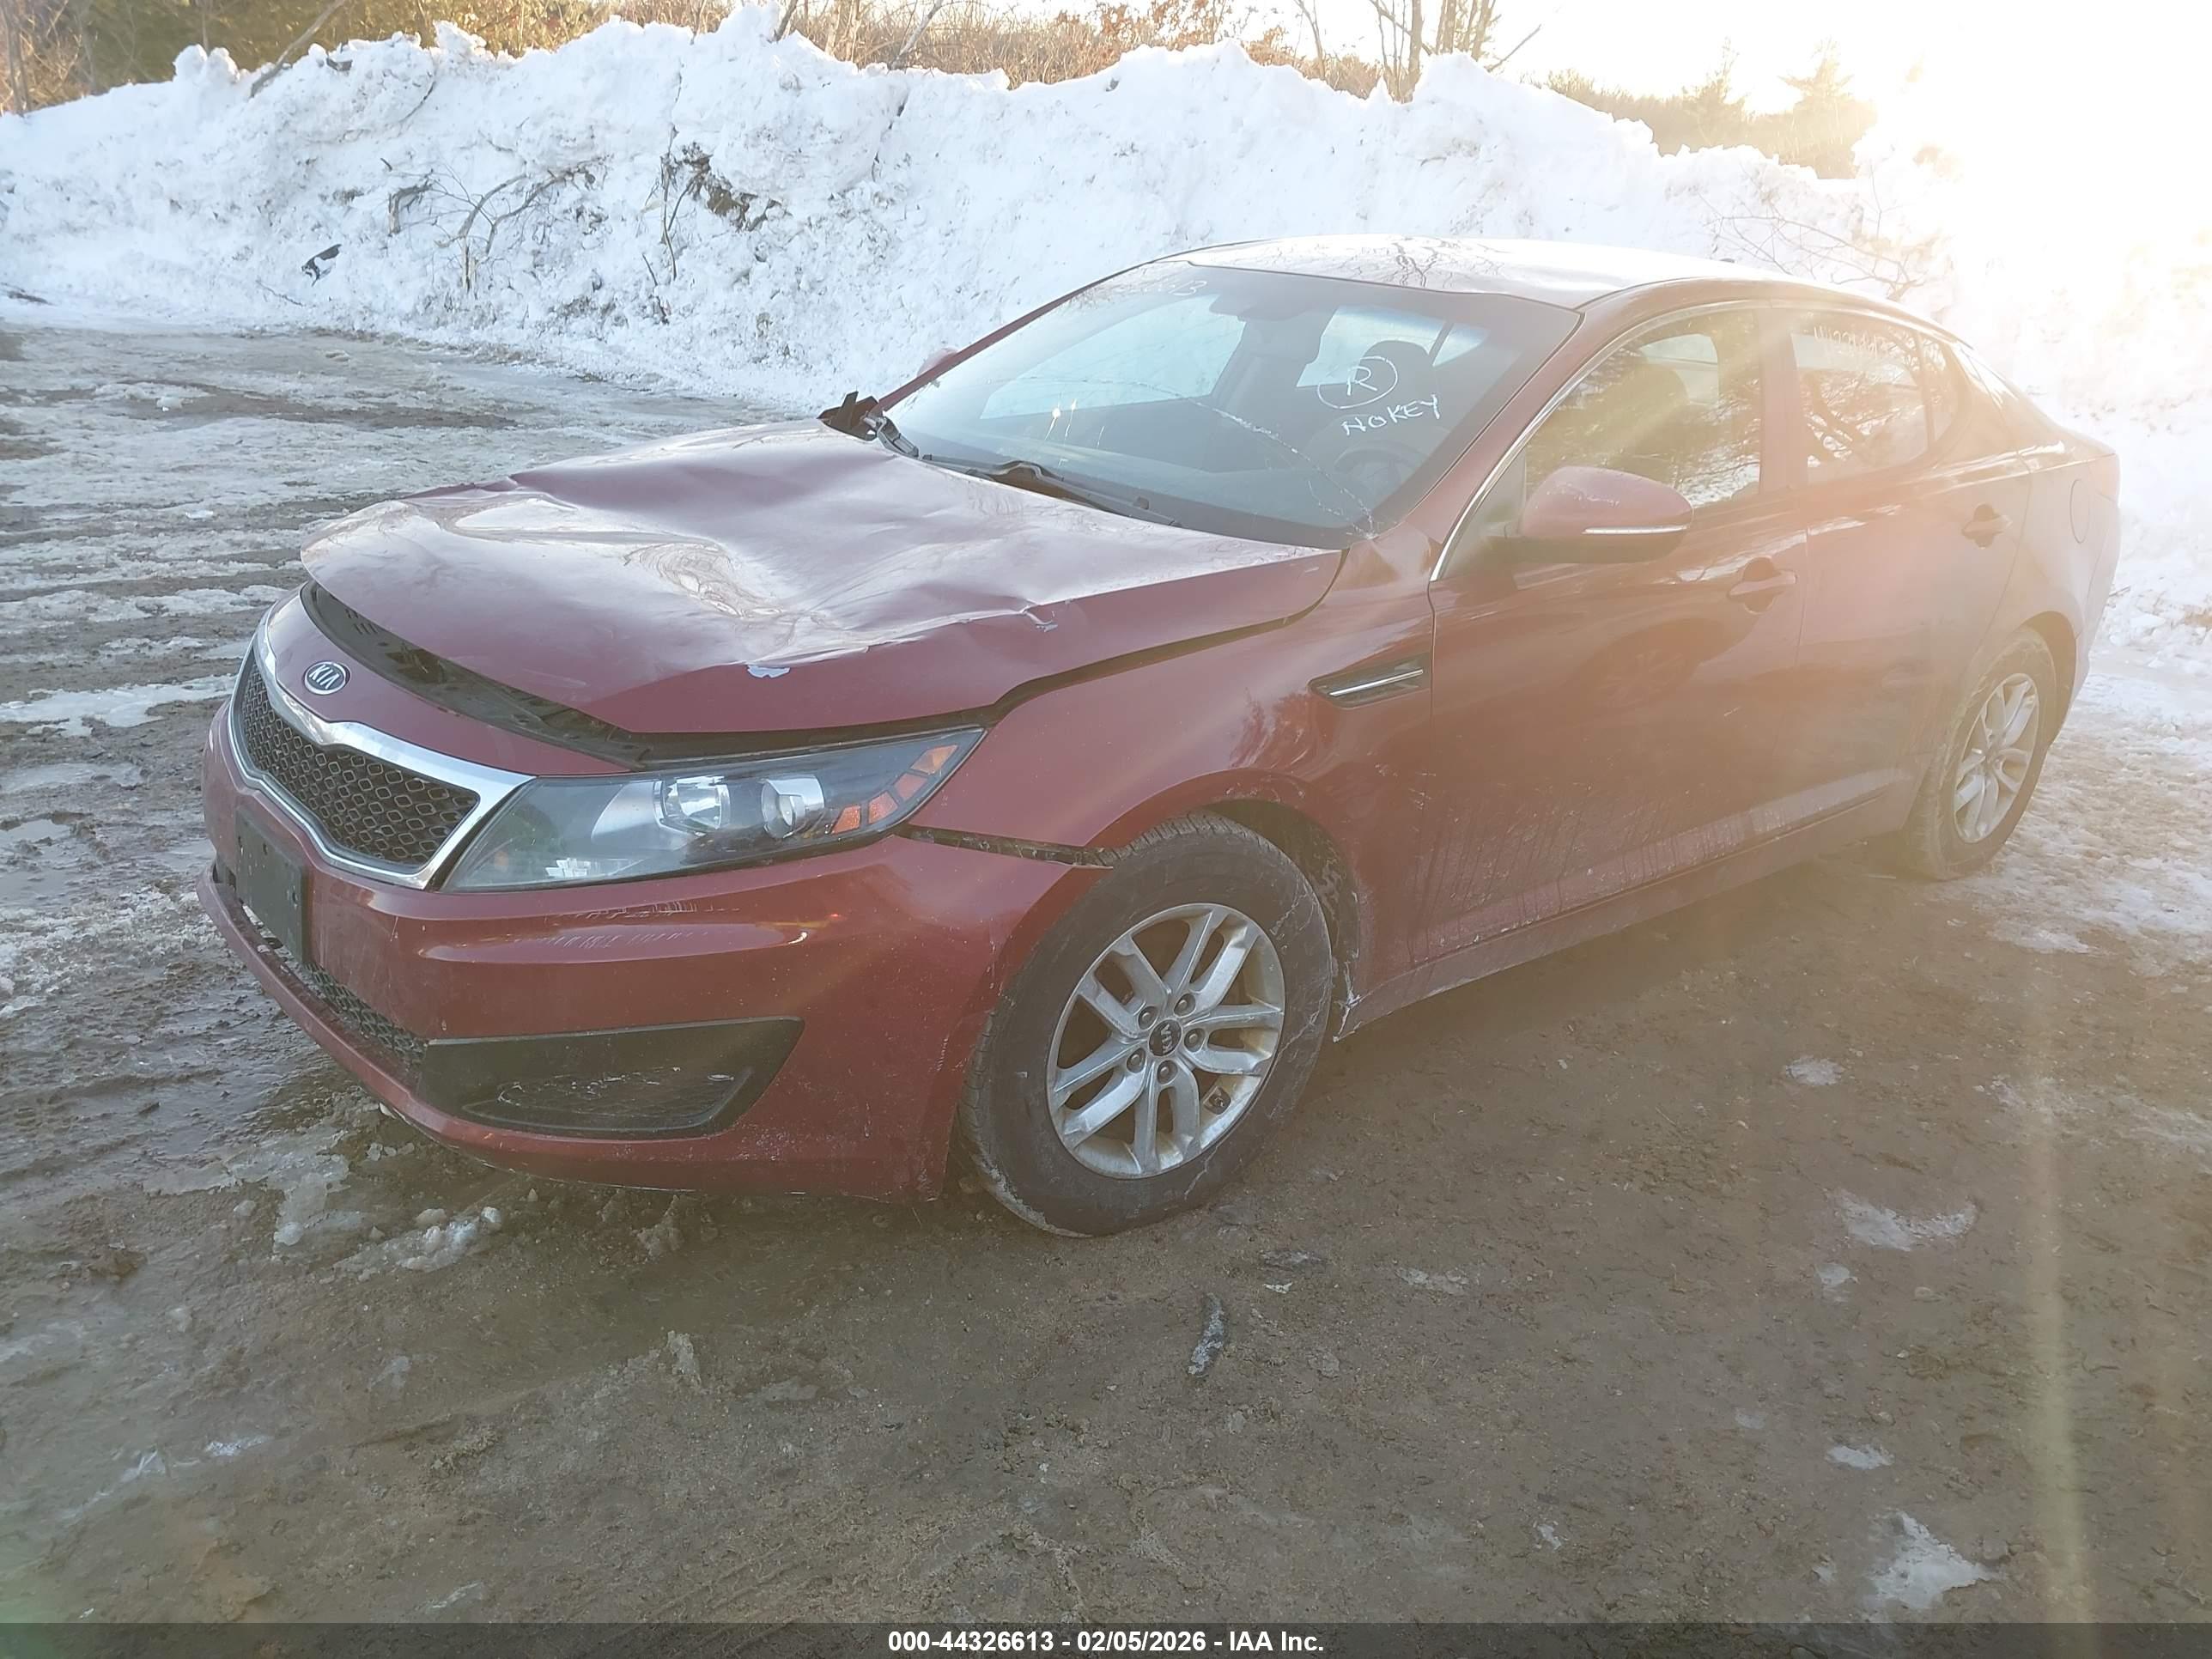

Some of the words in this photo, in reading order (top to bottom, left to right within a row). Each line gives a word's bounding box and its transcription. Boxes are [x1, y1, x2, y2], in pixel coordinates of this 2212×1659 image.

[1346, 366, 1378, 396] R
[308, 664, 341, 690] KIA
[1160, 1023, 1174, 1054] KIA
